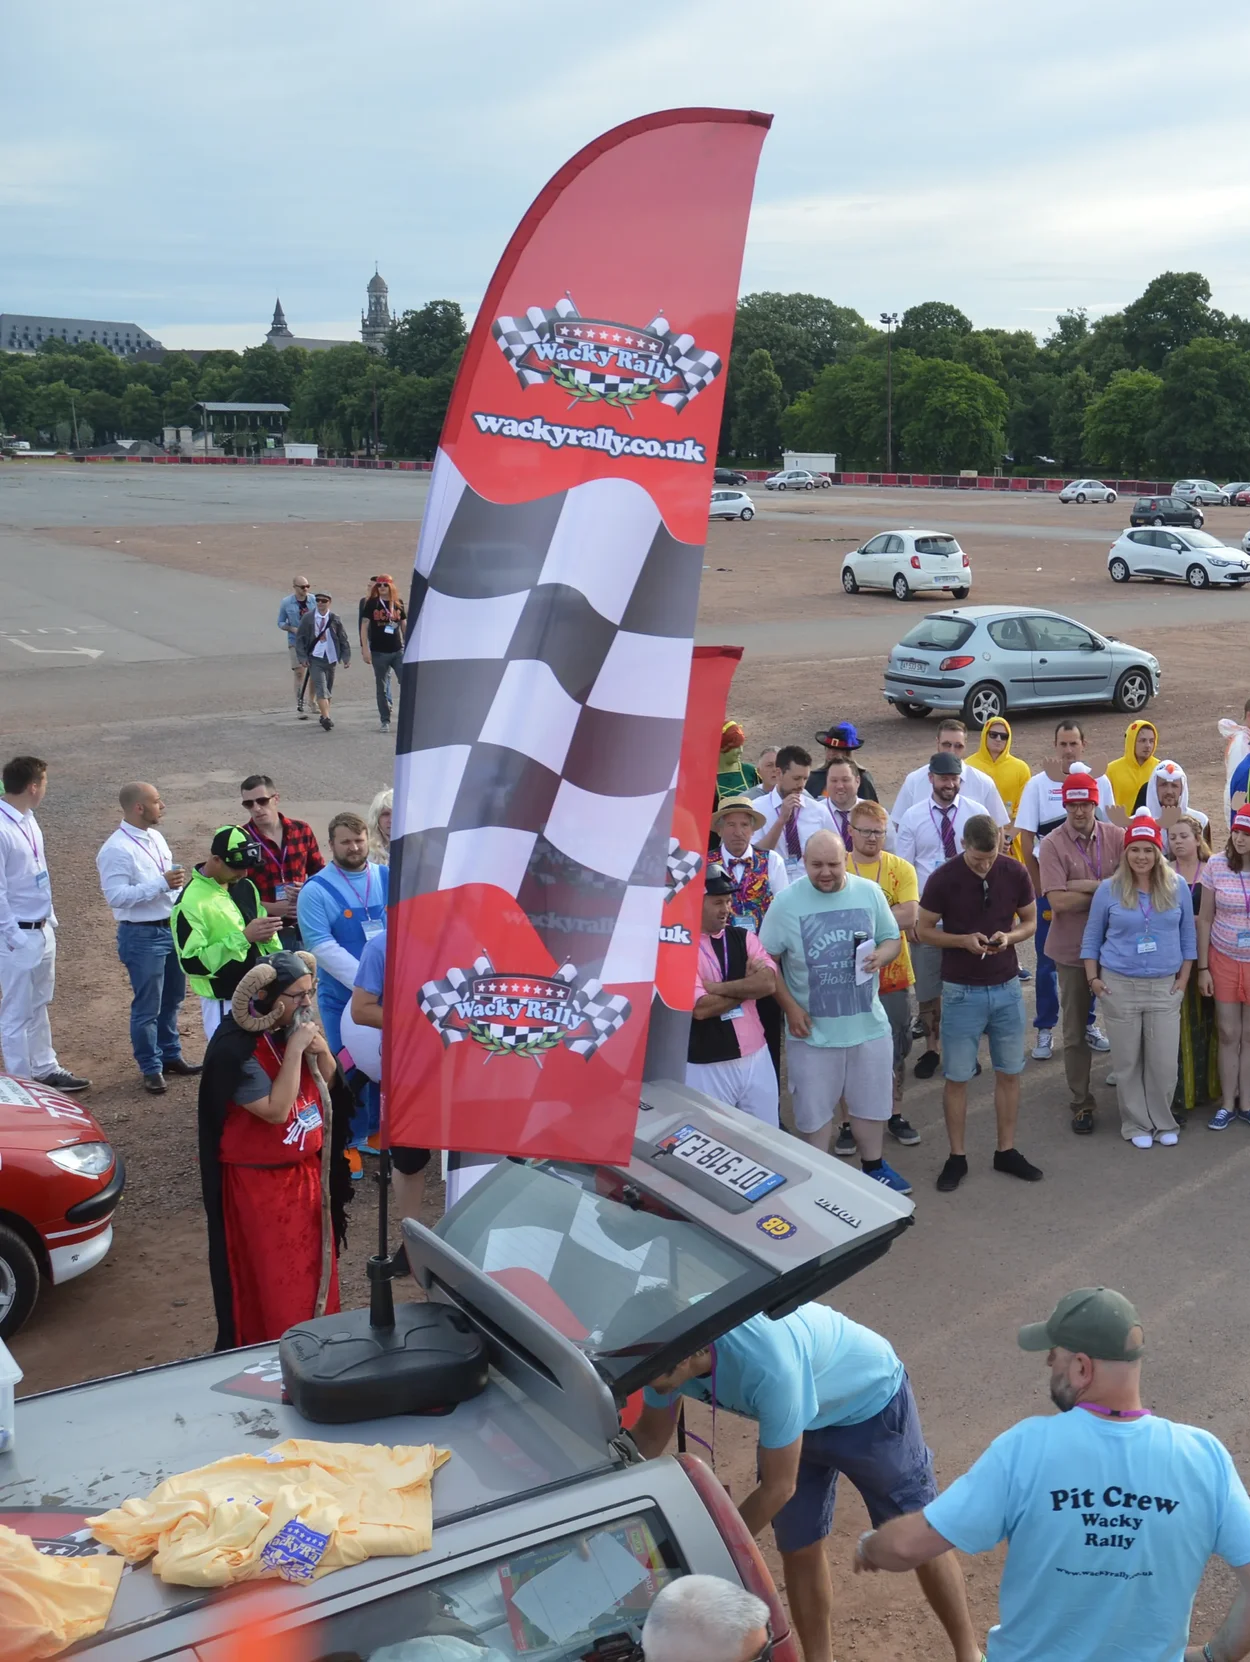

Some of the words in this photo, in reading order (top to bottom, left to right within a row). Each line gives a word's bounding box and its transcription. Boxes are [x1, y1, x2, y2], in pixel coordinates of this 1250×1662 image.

[533, 342, 615, 367] Wacky
[616, 350, 678, 384] Rally
[474, 413, 705, 462] wackyrally.co.uk
[808, 929, 854, 960] SUNRI
[454, 999, 525, 1019] Wacky
[525, 1000, 586, 1030] Rally
[762, 1216, 792, 1236] GB
[1049, 1487, 1095, 1512] Pit
[1102, 1485, 1180, 1515] Crew
[1081, 1513, 1143, 1530] Wacky
[1084, 1533, 1136, 1550] Rally
